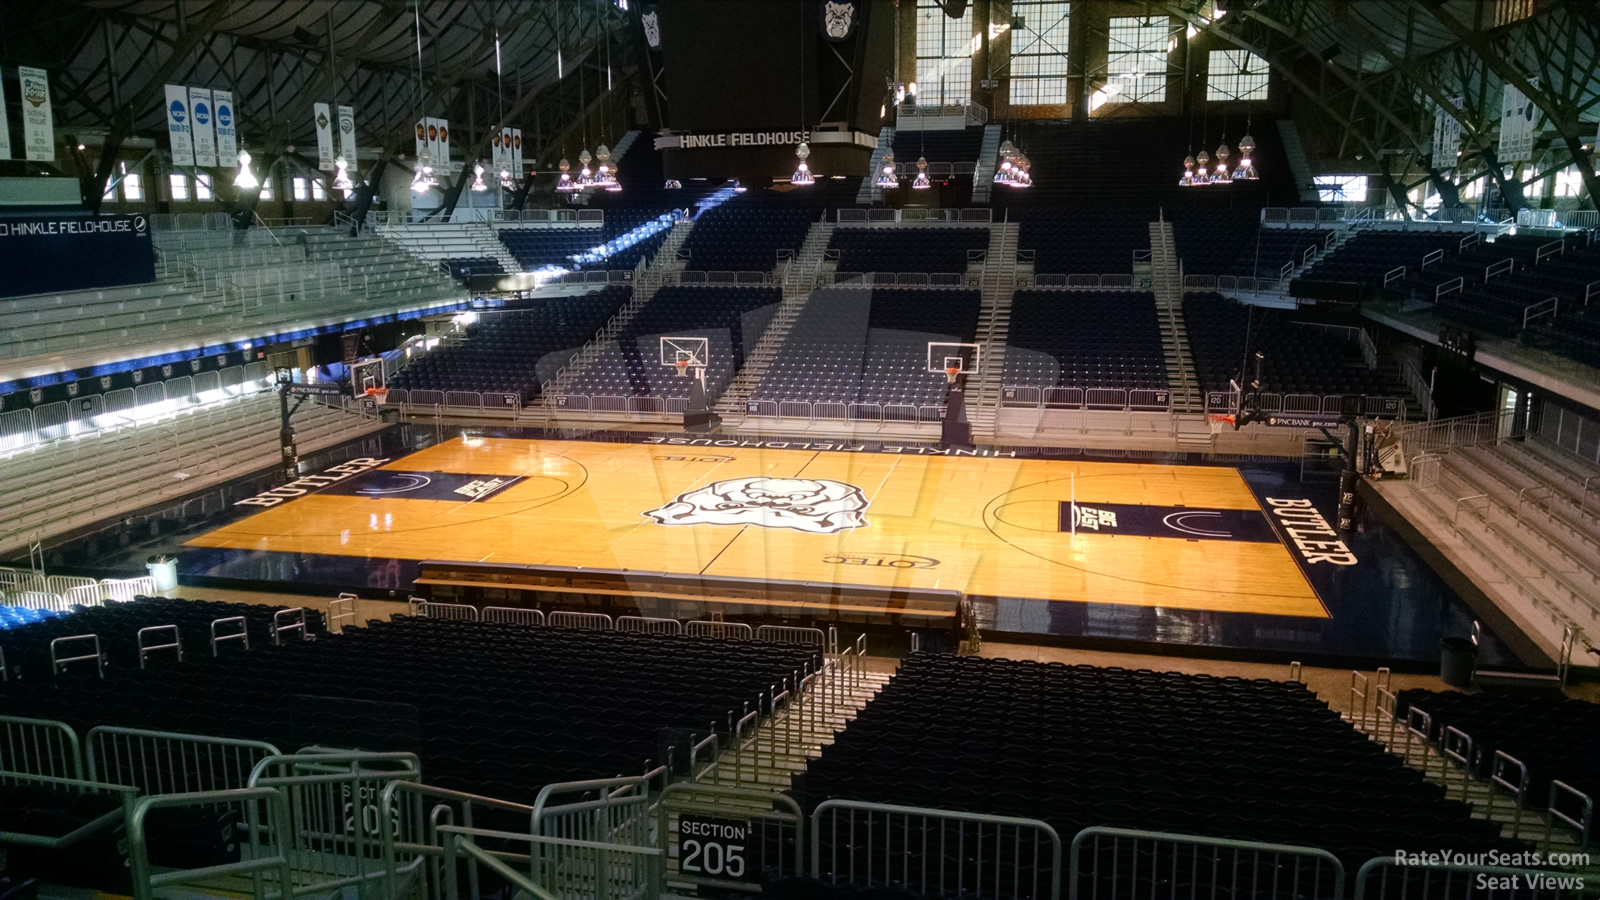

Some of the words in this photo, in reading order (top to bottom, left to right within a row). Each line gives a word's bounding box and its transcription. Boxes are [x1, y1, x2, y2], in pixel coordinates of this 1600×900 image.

[172, 110, 187, 118] NCAA
[680, 134, 726, 149] HINKLE
[731, 131, 810, 146] FIELDHOUSE
[11, 222, 57, 235] HINKLE
[60, 220, 132, 234] FIELDHOUSE
[641, 436, 865, 451] FIELDHOUSE
[881, 445, 1016, 458] HINKLE
[232, 457, 392, 508] BUTLER
[1081, 506, 1099, 531] EAST
[1097, 509, 1118, 528] BIG
[1265, 497, 1359, 566] BUTLER
[682, 821, 745, 839] SECTION
[682, 838, 746, 877] 205
